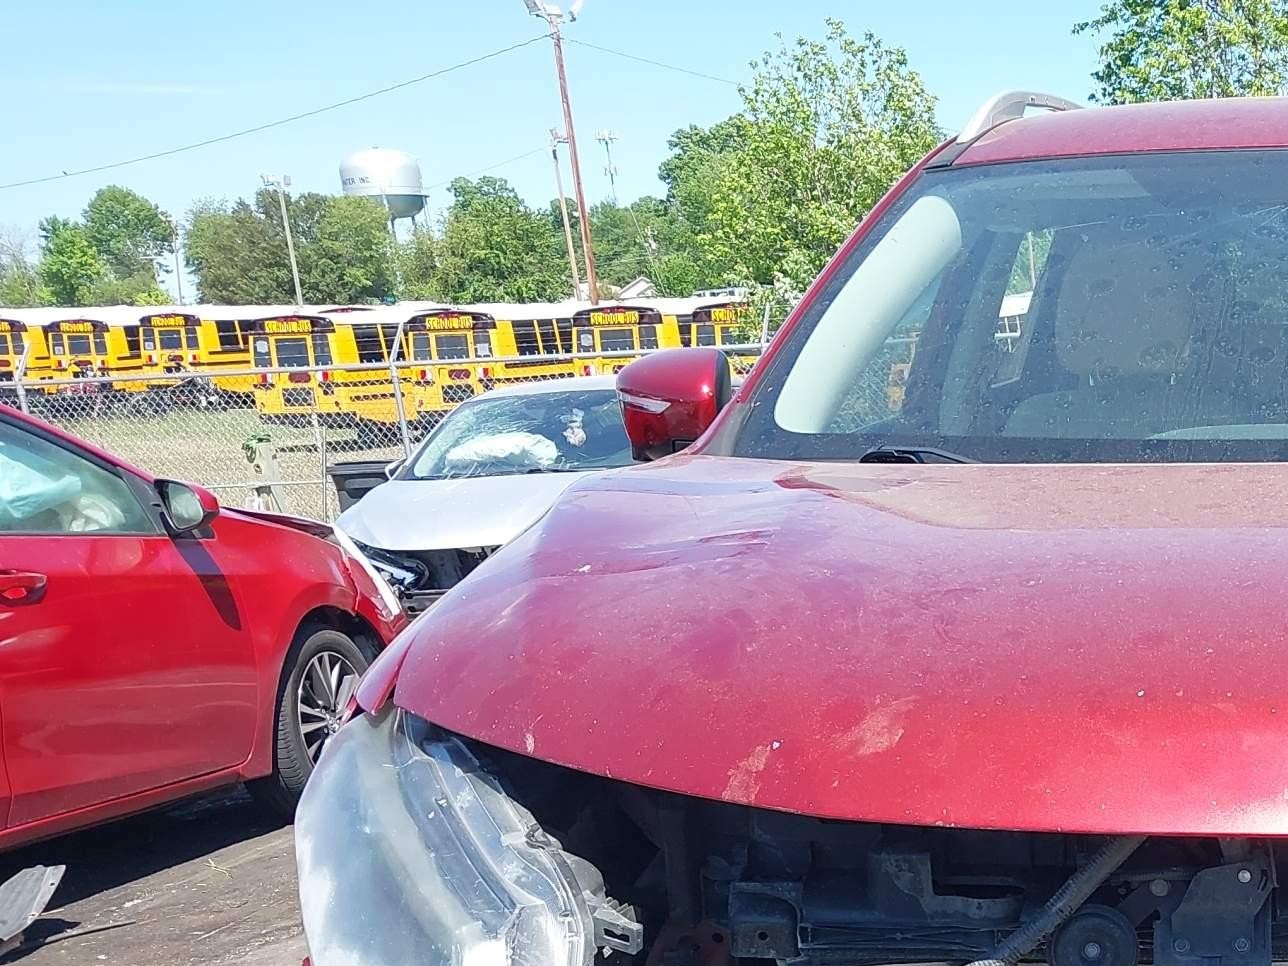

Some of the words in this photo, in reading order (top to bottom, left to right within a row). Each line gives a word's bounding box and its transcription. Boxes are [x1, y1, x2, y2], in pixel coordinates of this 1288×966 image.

[591, 314, 621, 325] SCHOOL
[623, 313, 638, 324] BUS
[712, 310, 739, 321] SCHO
[266, 321, 295, 332] SCHOOL
[296, 320, 310, 331] BUS
[427, 318, 456, 329] SCHOOL
[457, 317, 472, 328] BUS
